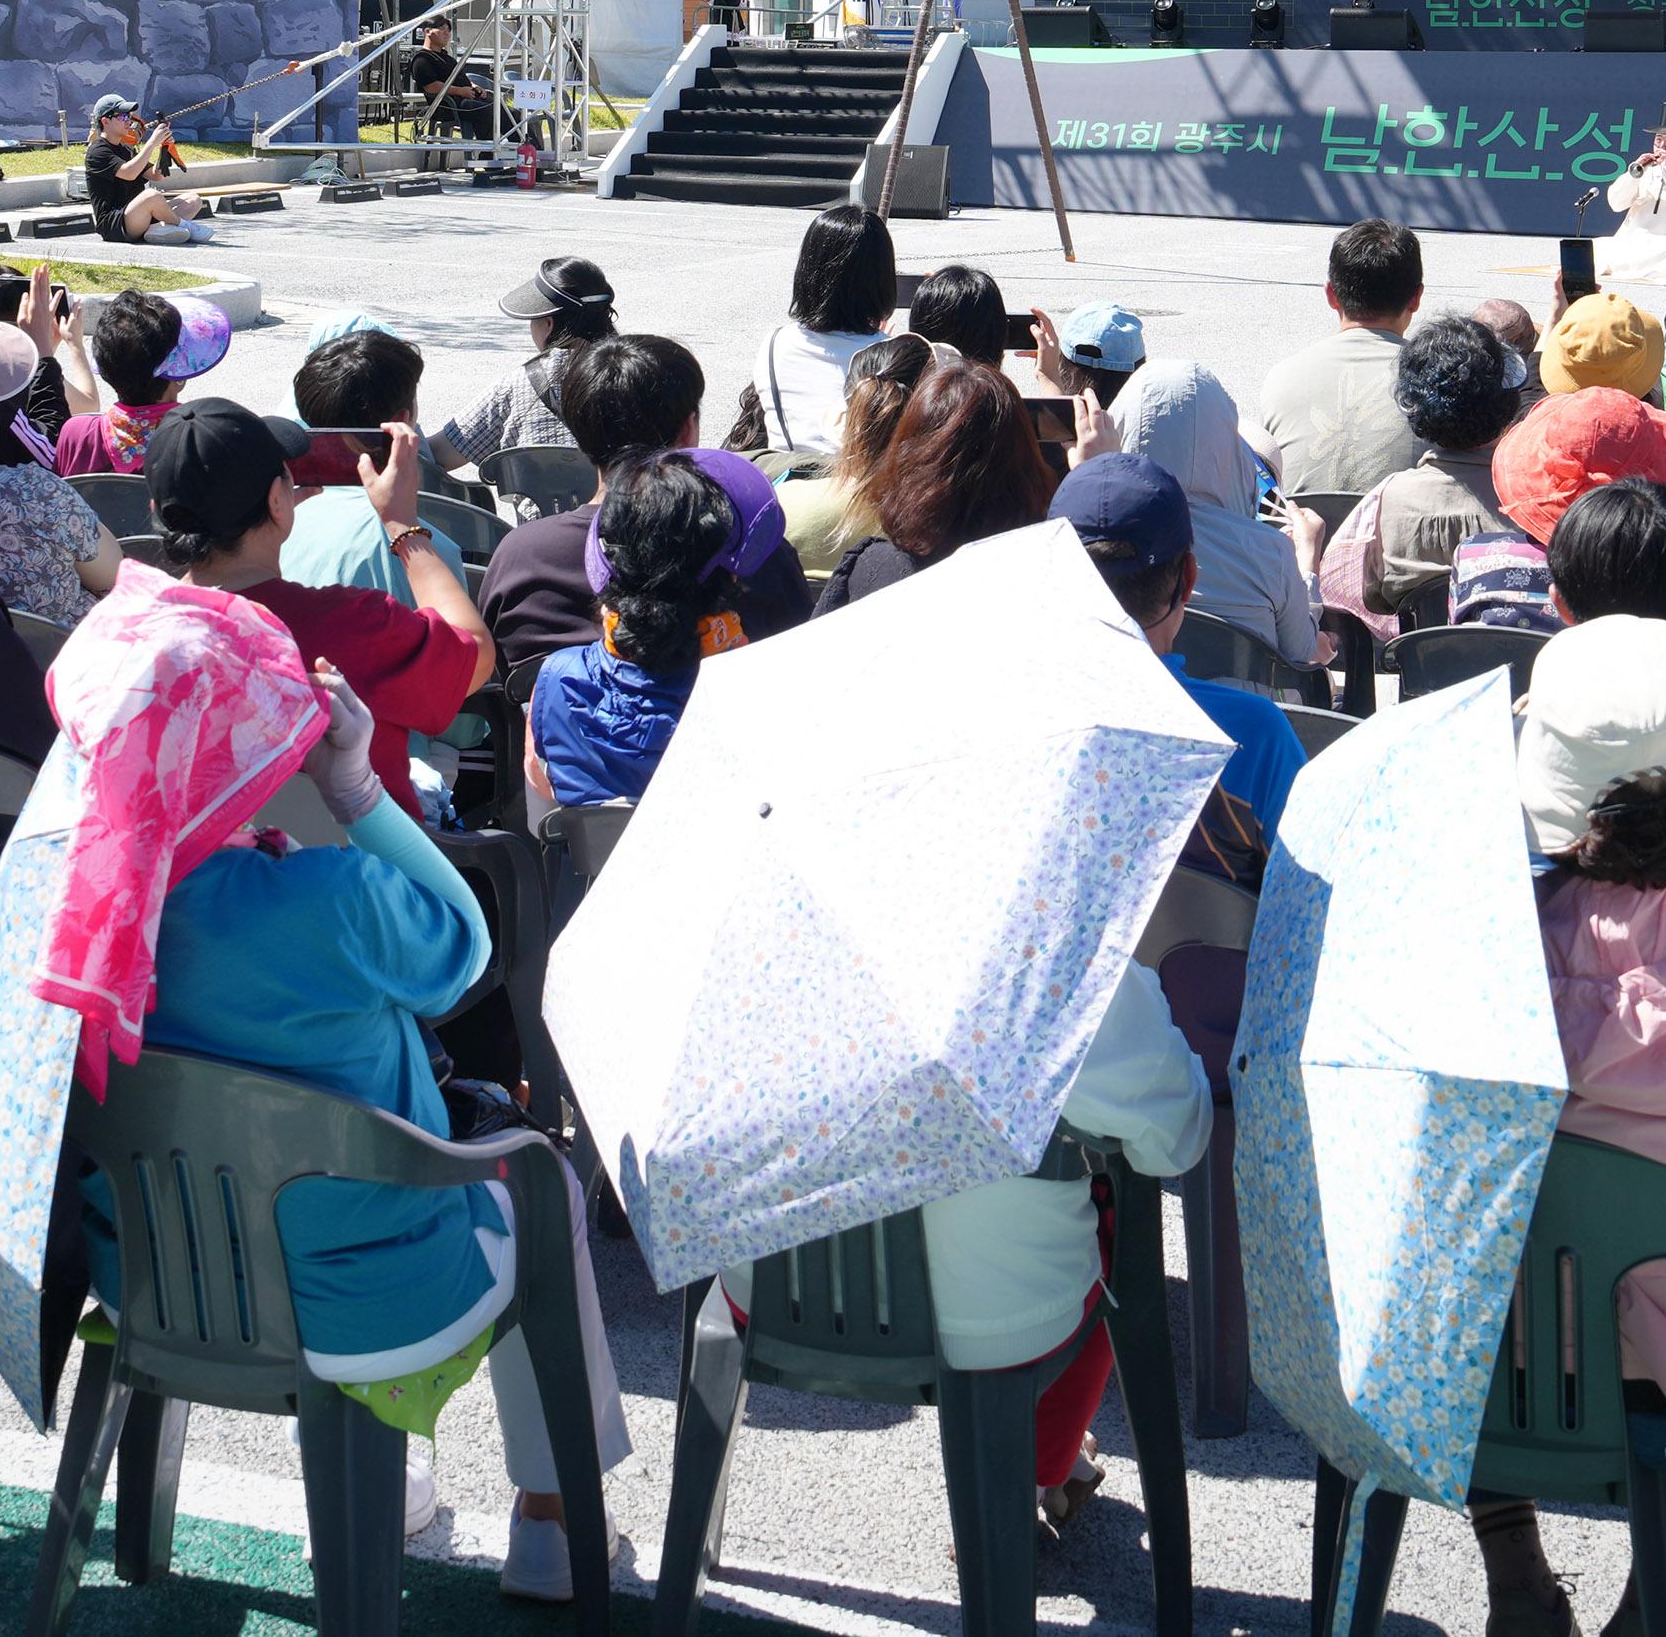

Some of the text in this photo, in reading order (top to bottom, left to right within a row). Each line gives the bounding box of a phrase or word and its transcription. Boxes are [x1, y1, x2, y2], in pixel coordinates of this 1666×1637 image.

[1051, 119, 1163, 152] 제31회
[1173, 121, 1283, 155] 광주시
[1319, 103, 1634, 182] 남한산성
